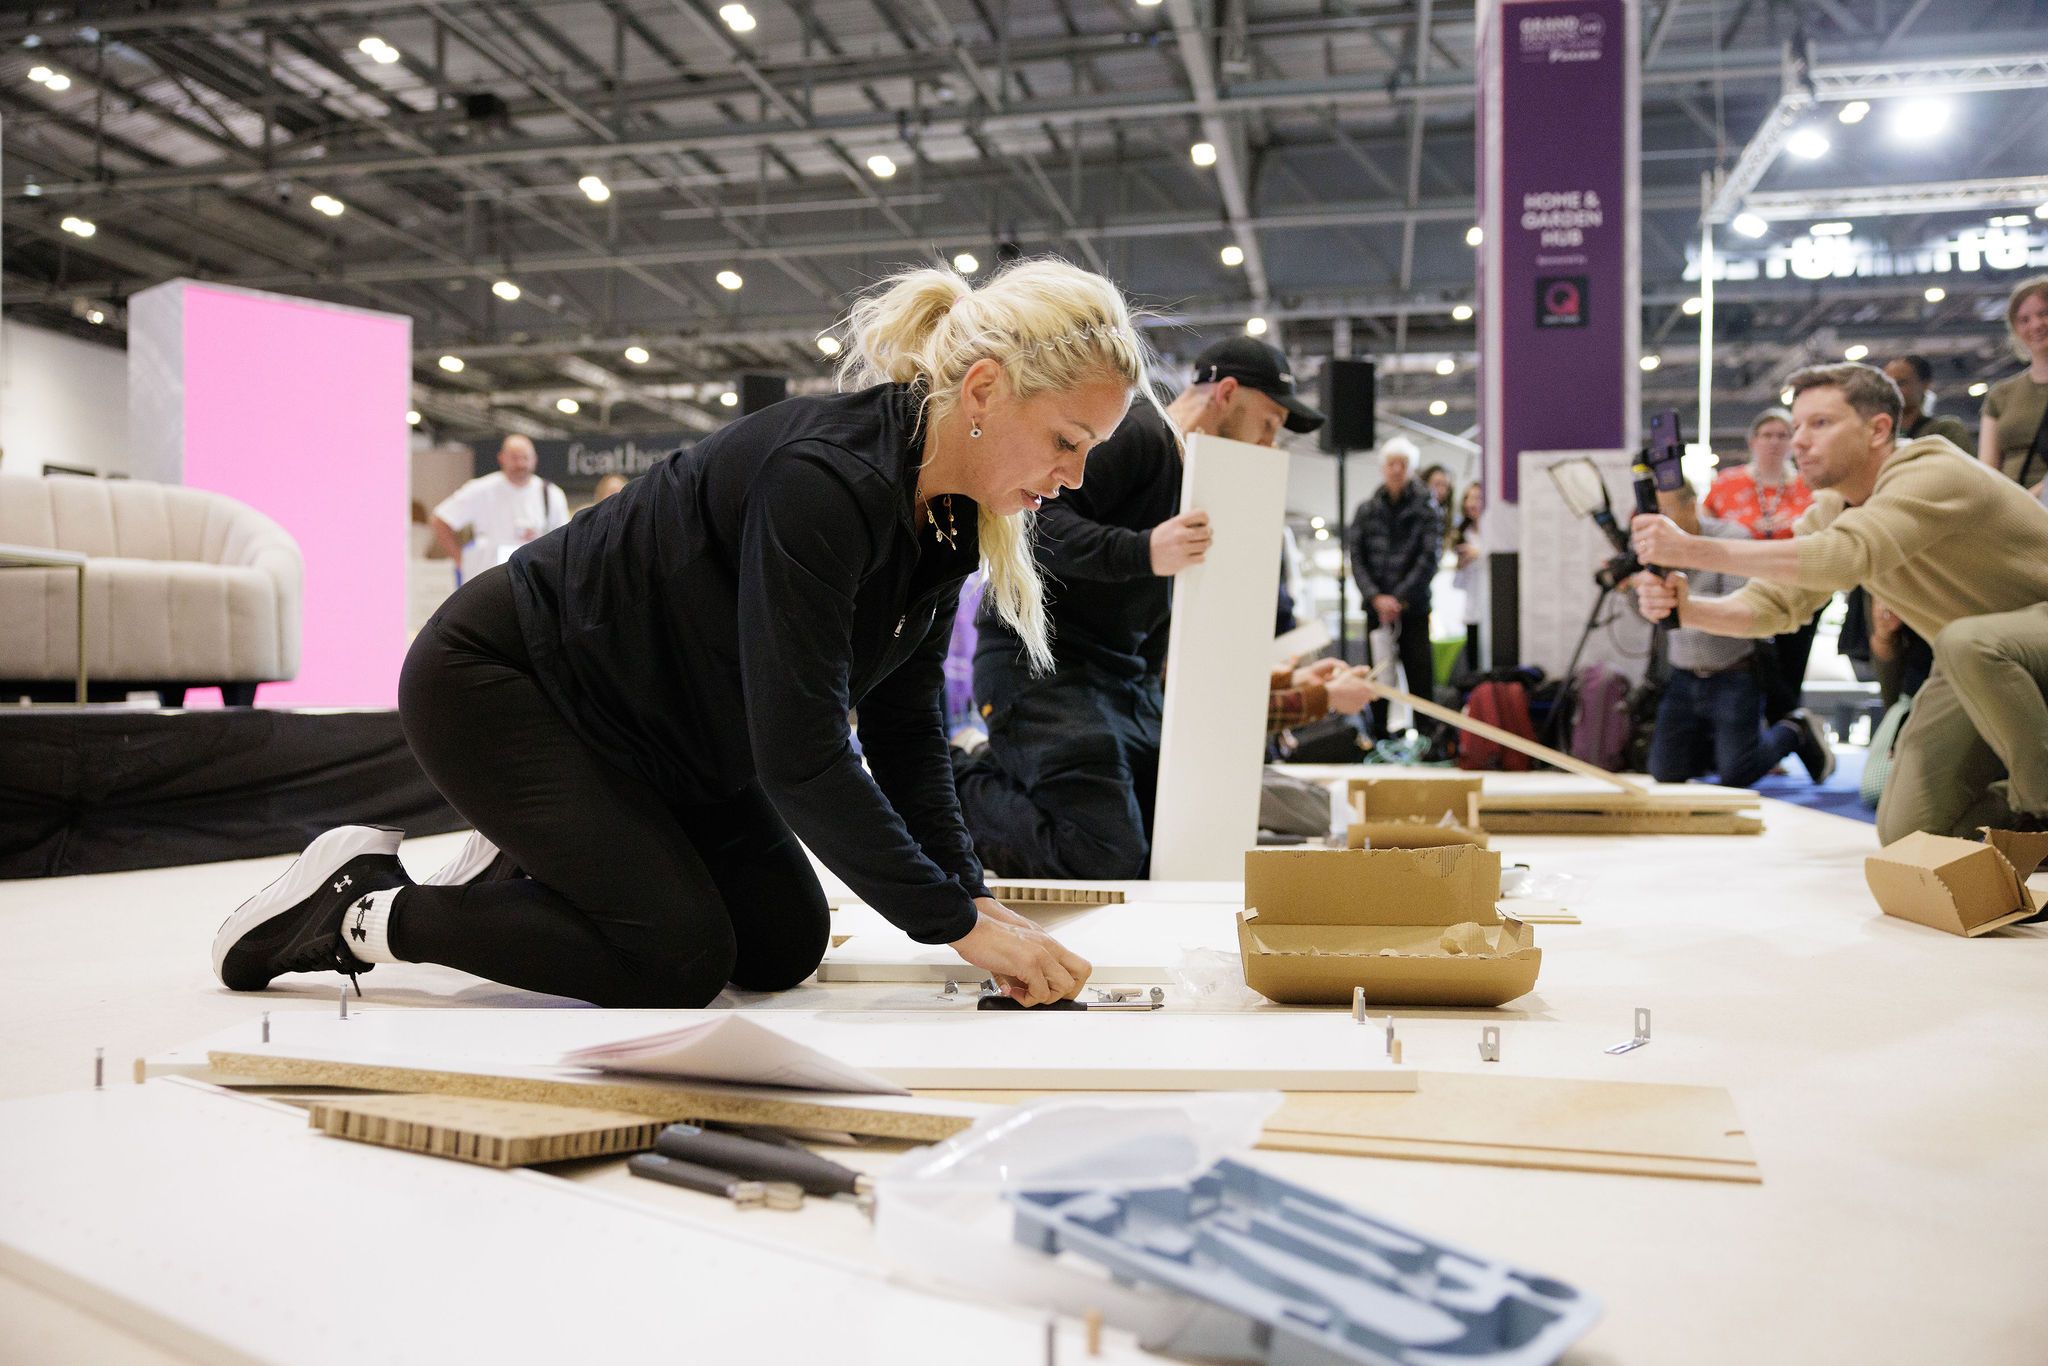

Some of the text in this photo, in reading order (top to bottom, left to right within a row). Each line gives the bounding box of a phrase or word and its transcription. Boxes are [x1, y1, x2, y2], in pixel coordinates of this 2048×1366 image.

[1523, 190, 1600, 211] HOME &
[1521, 208, 1603, 230] GARDEN
[1540, 229, 1583, 248] HUB
